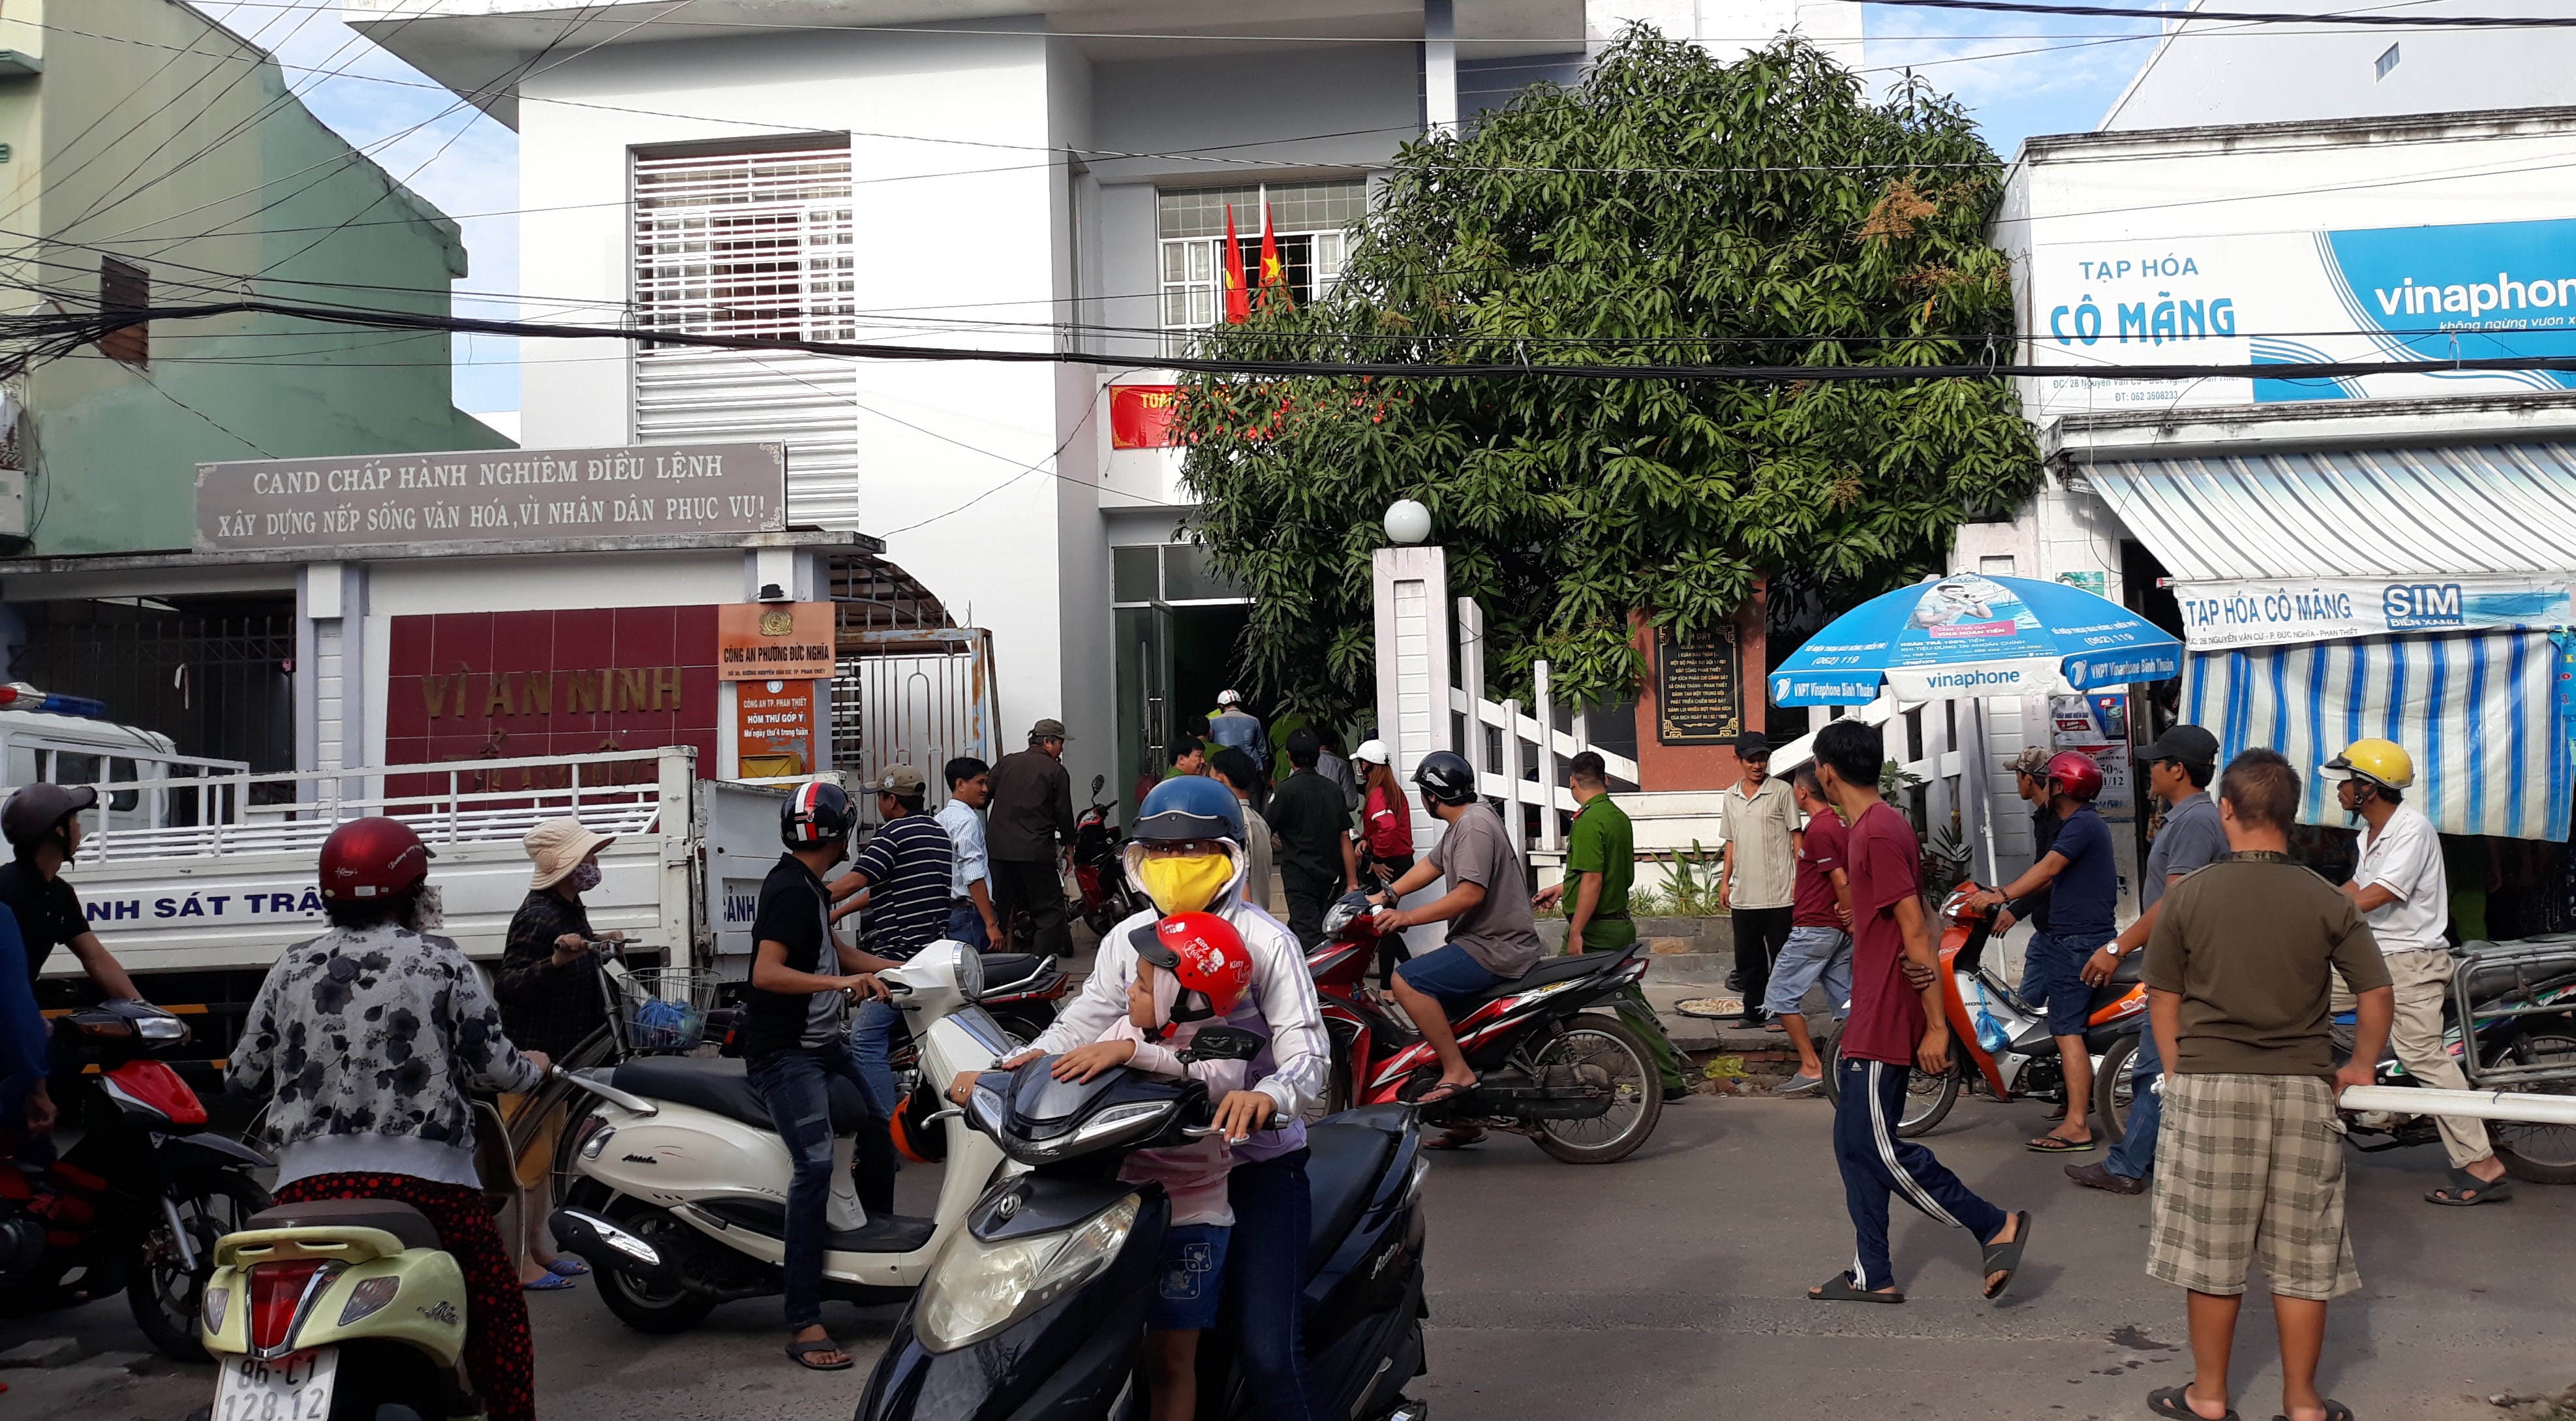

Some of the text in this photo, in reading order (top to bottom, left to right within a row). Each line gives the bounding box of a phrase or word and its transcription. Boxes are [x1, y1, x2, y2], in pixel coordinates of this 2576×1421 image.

[2079, 253, 2199, 283] TẠP HÓA
[2374, 271, 2576, 317] vinaphon
[2051, 291, 2236, 347] CÔ MÃNG
[2070, 379, 2079, 388] 28
[2115, 393, 2128, 401] ĐT:
[253, 449, 723, 495] CAND CHẤP HÀNH NGHIÊM ĐIỀU LỆNH
[218, 510, 256, 537] XÂY
[267, 508, 316, 541] DỰNG
[324, 502, 360, 533] NẾP
[367, 500, 416, 531] SỐNG
[423, 500, 460, 529] VĂN
[548, 495, 604, 525] NHÂN
[614, 493, 654, 523] DÂN
[666, 496, 718, 526] PHỤC
[729, 495, 765, 523] VỤ!
[2186, 587, 2353, 632] TẠP HÓA CÔ MÃNG
[2387, 587, 2459, 617] SIM
[2084, 635, 2114, 646] (062)
[724, 642, 829, 663] CÔNG AN PHƯỜNG ĐỨC NGHĨA
[1811, 656, 1839, 666] (062)
[1926, 670, 2020, 688] vinaphone
[2091, 663, 2109, 679] VNPT
[422, 660, 682, 718] VÌ AN NINH
[1794, 682, 1809, 697] VNPT
[1811, 682, 1841, 699] Vinaphone
[1842, 681, 1855, 696] Bình
[744, 697, 758, 708] CÔNG
[765, 712, 780, 723] THƯ
[782, 711, 797, 722] GÓP
[86, 886, 324, 921] NH SÁT TRẬ
[723, 885, 755, 923] ẢNH
[1183, 940, 1204, 961] Love
[1194, 937, 1210, 951] Kitty
[1229, 960, 1244, 970] Kitty
[238, 1354, 318, 1390] 86-C1
[224, 1388, 324, 1421] 128.12
